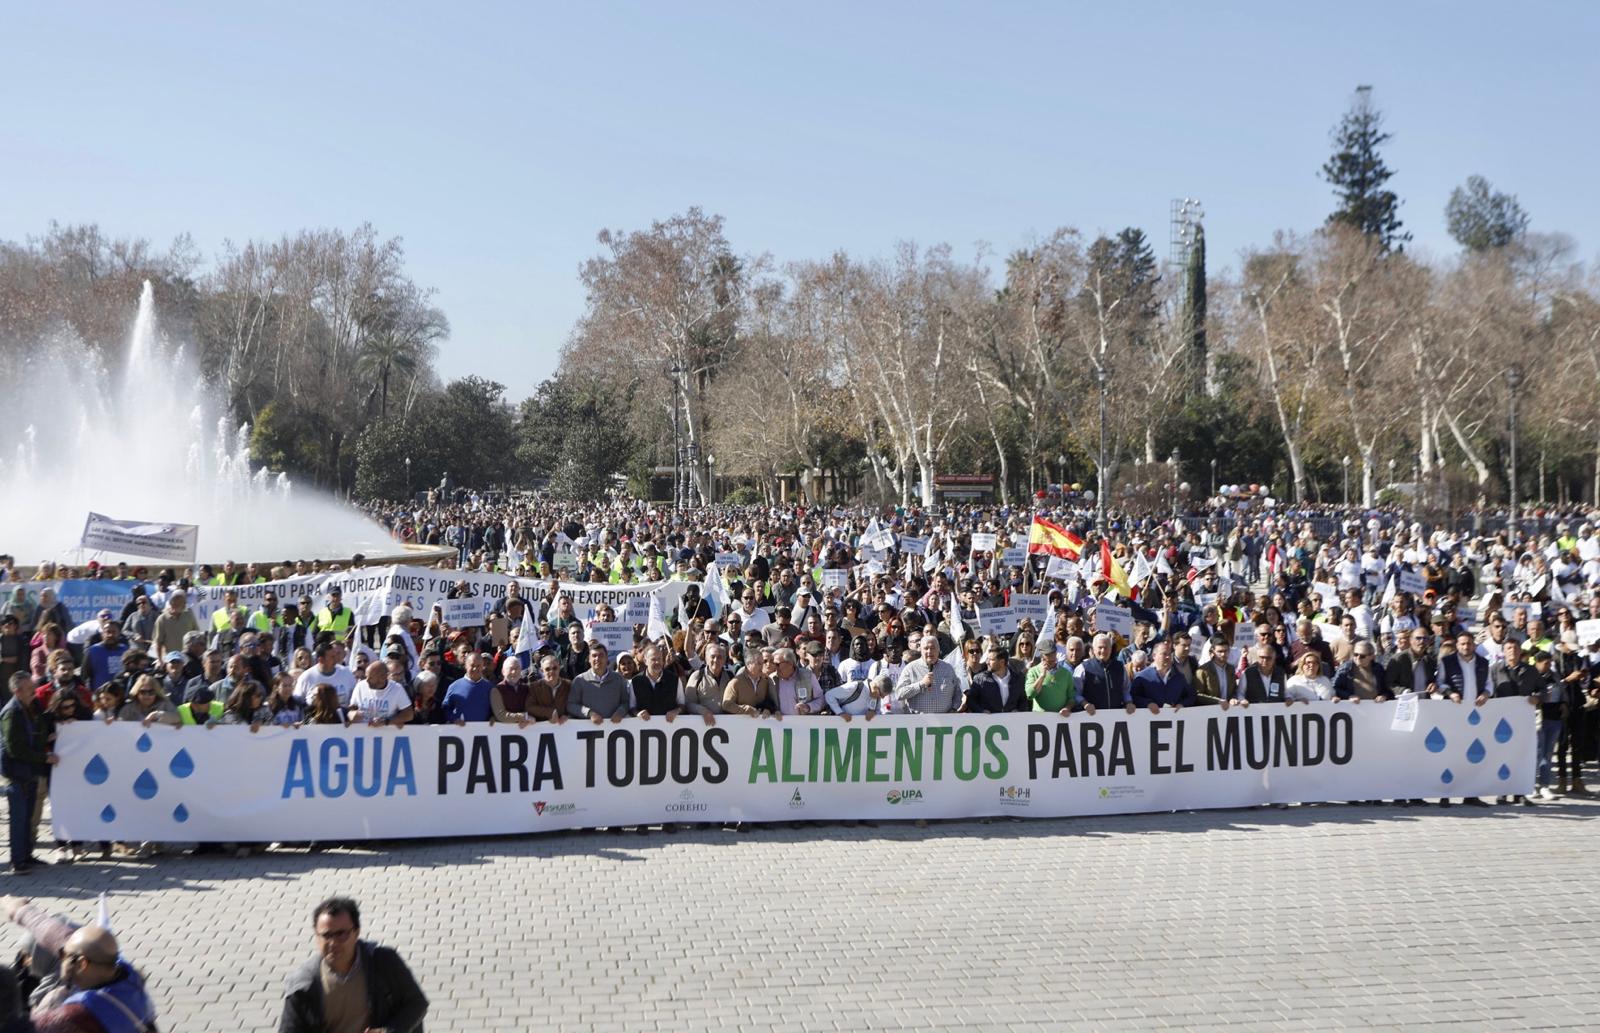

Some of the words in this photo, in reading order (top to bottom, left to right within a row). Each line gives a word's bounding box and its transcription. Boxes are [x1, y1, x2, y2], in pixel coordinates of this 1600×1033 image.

[290, 583, 322, 598] PARA
[429, 578, 437, 593] Y
[483, 583, 507, 599] POR
[281, 735, 418, 799] AGUA
[437, 732, 565, 795] PARA
[576, 727, 730, 788] TODOS
[747, 724, 1011, 785] ALIMENTOS
[1027, 720, 1136, 780] PARA
[1149, 719, 1195, 775] EL
[1206, 711, 1354, 771] MUNDO
[901, 789, 923, 799] UPA
[664, 803, 708, 812] COREHU
